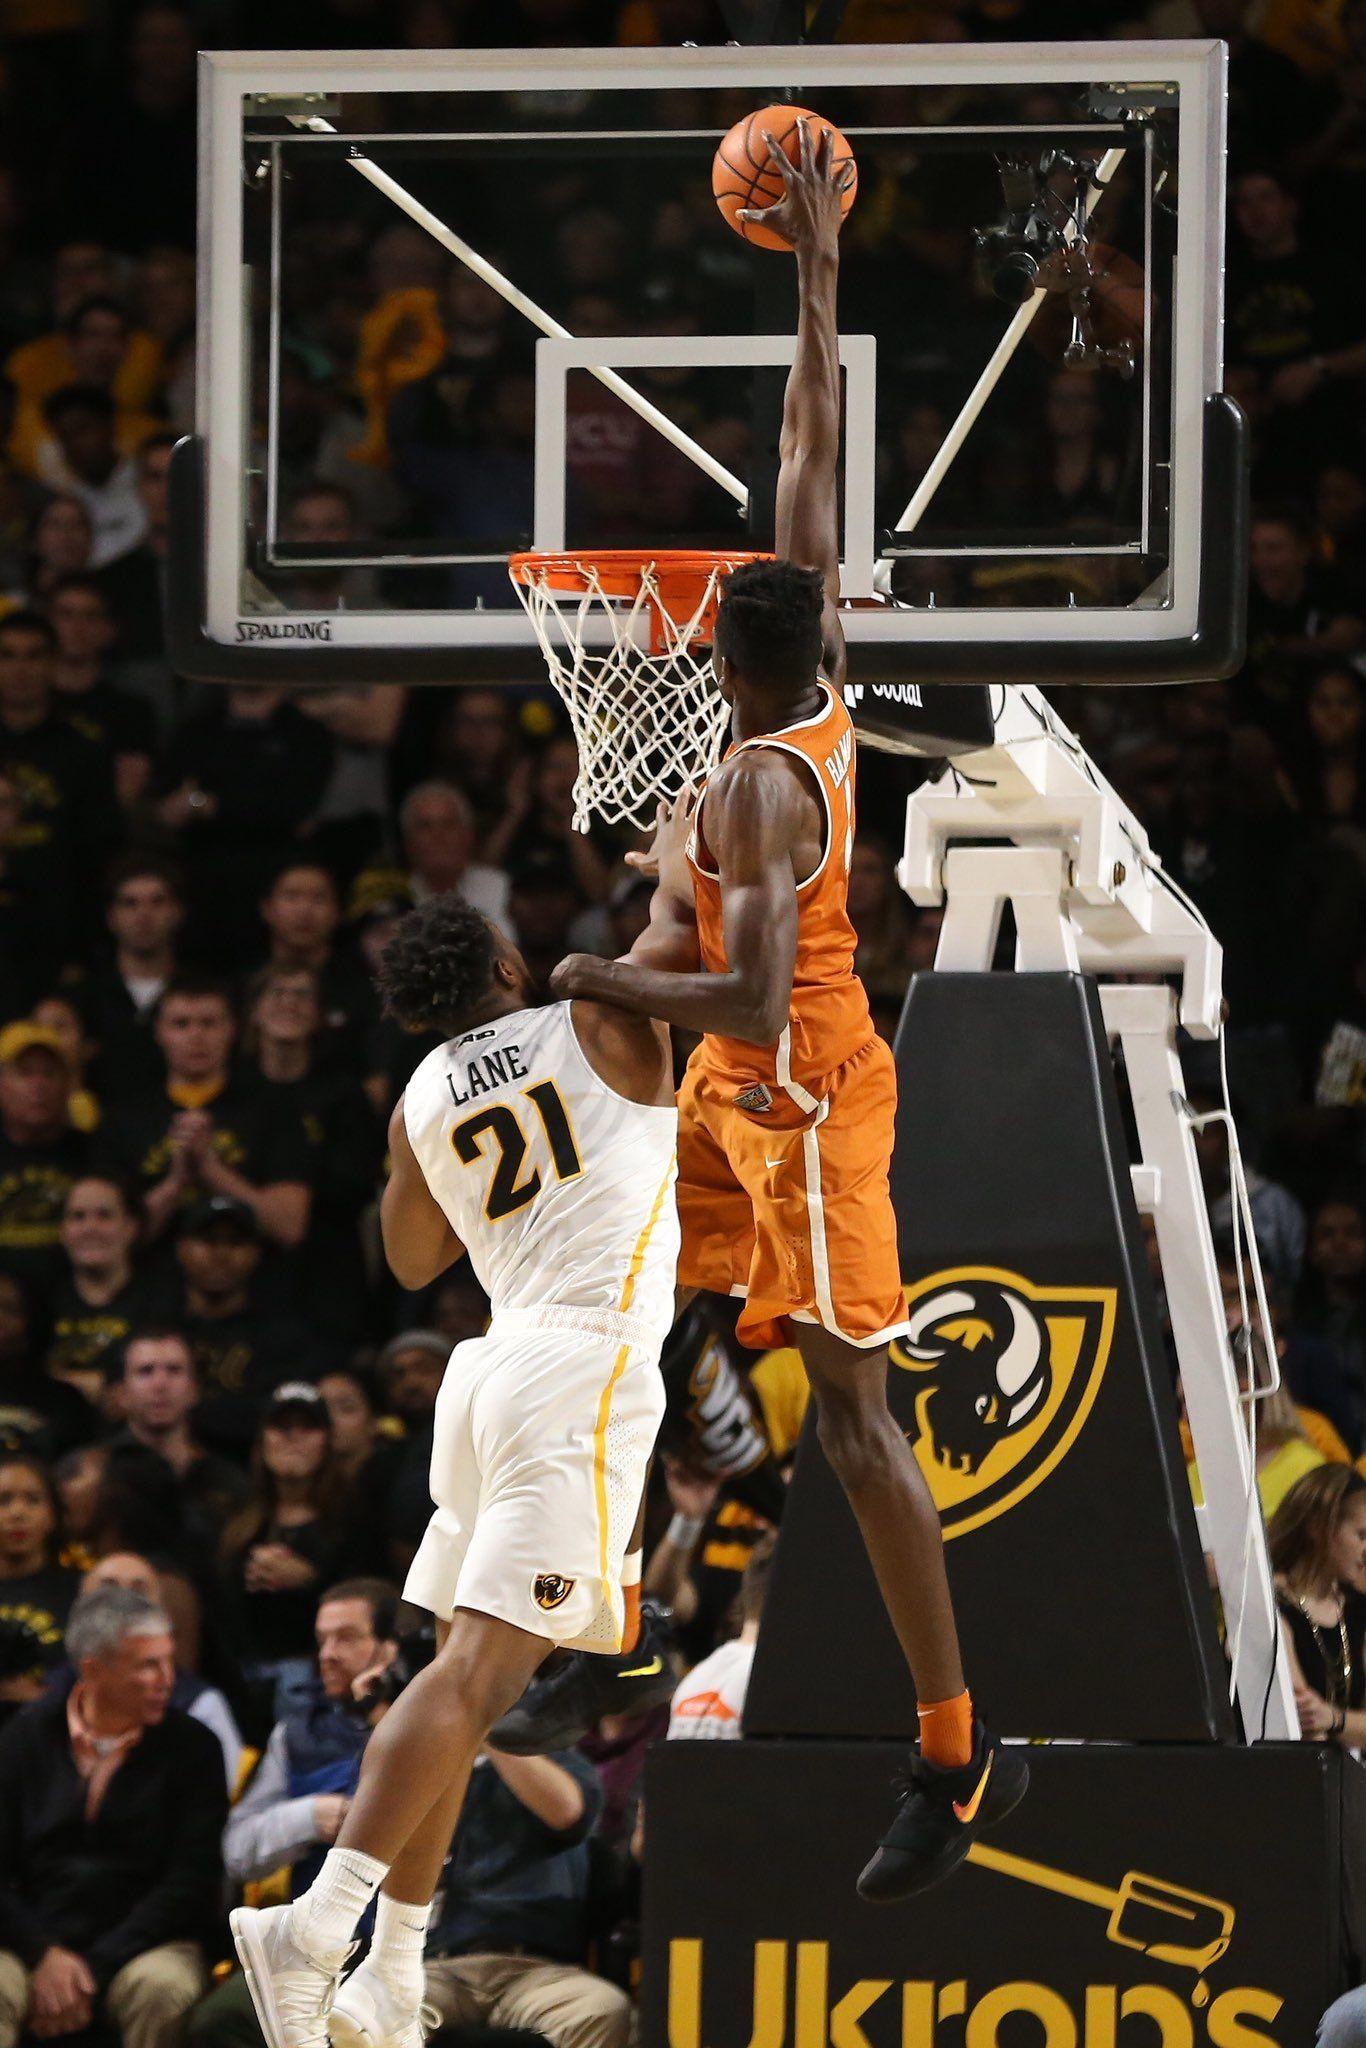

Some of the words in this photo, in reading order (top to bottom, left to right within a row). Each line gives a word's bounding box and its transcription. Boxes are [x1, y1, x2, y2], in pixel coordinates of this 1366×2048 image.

[236, 620, 332, 642] SPALDING
[446, 1045, 529, 1108] LANE
[450, 1076, 585, 1225] 21
